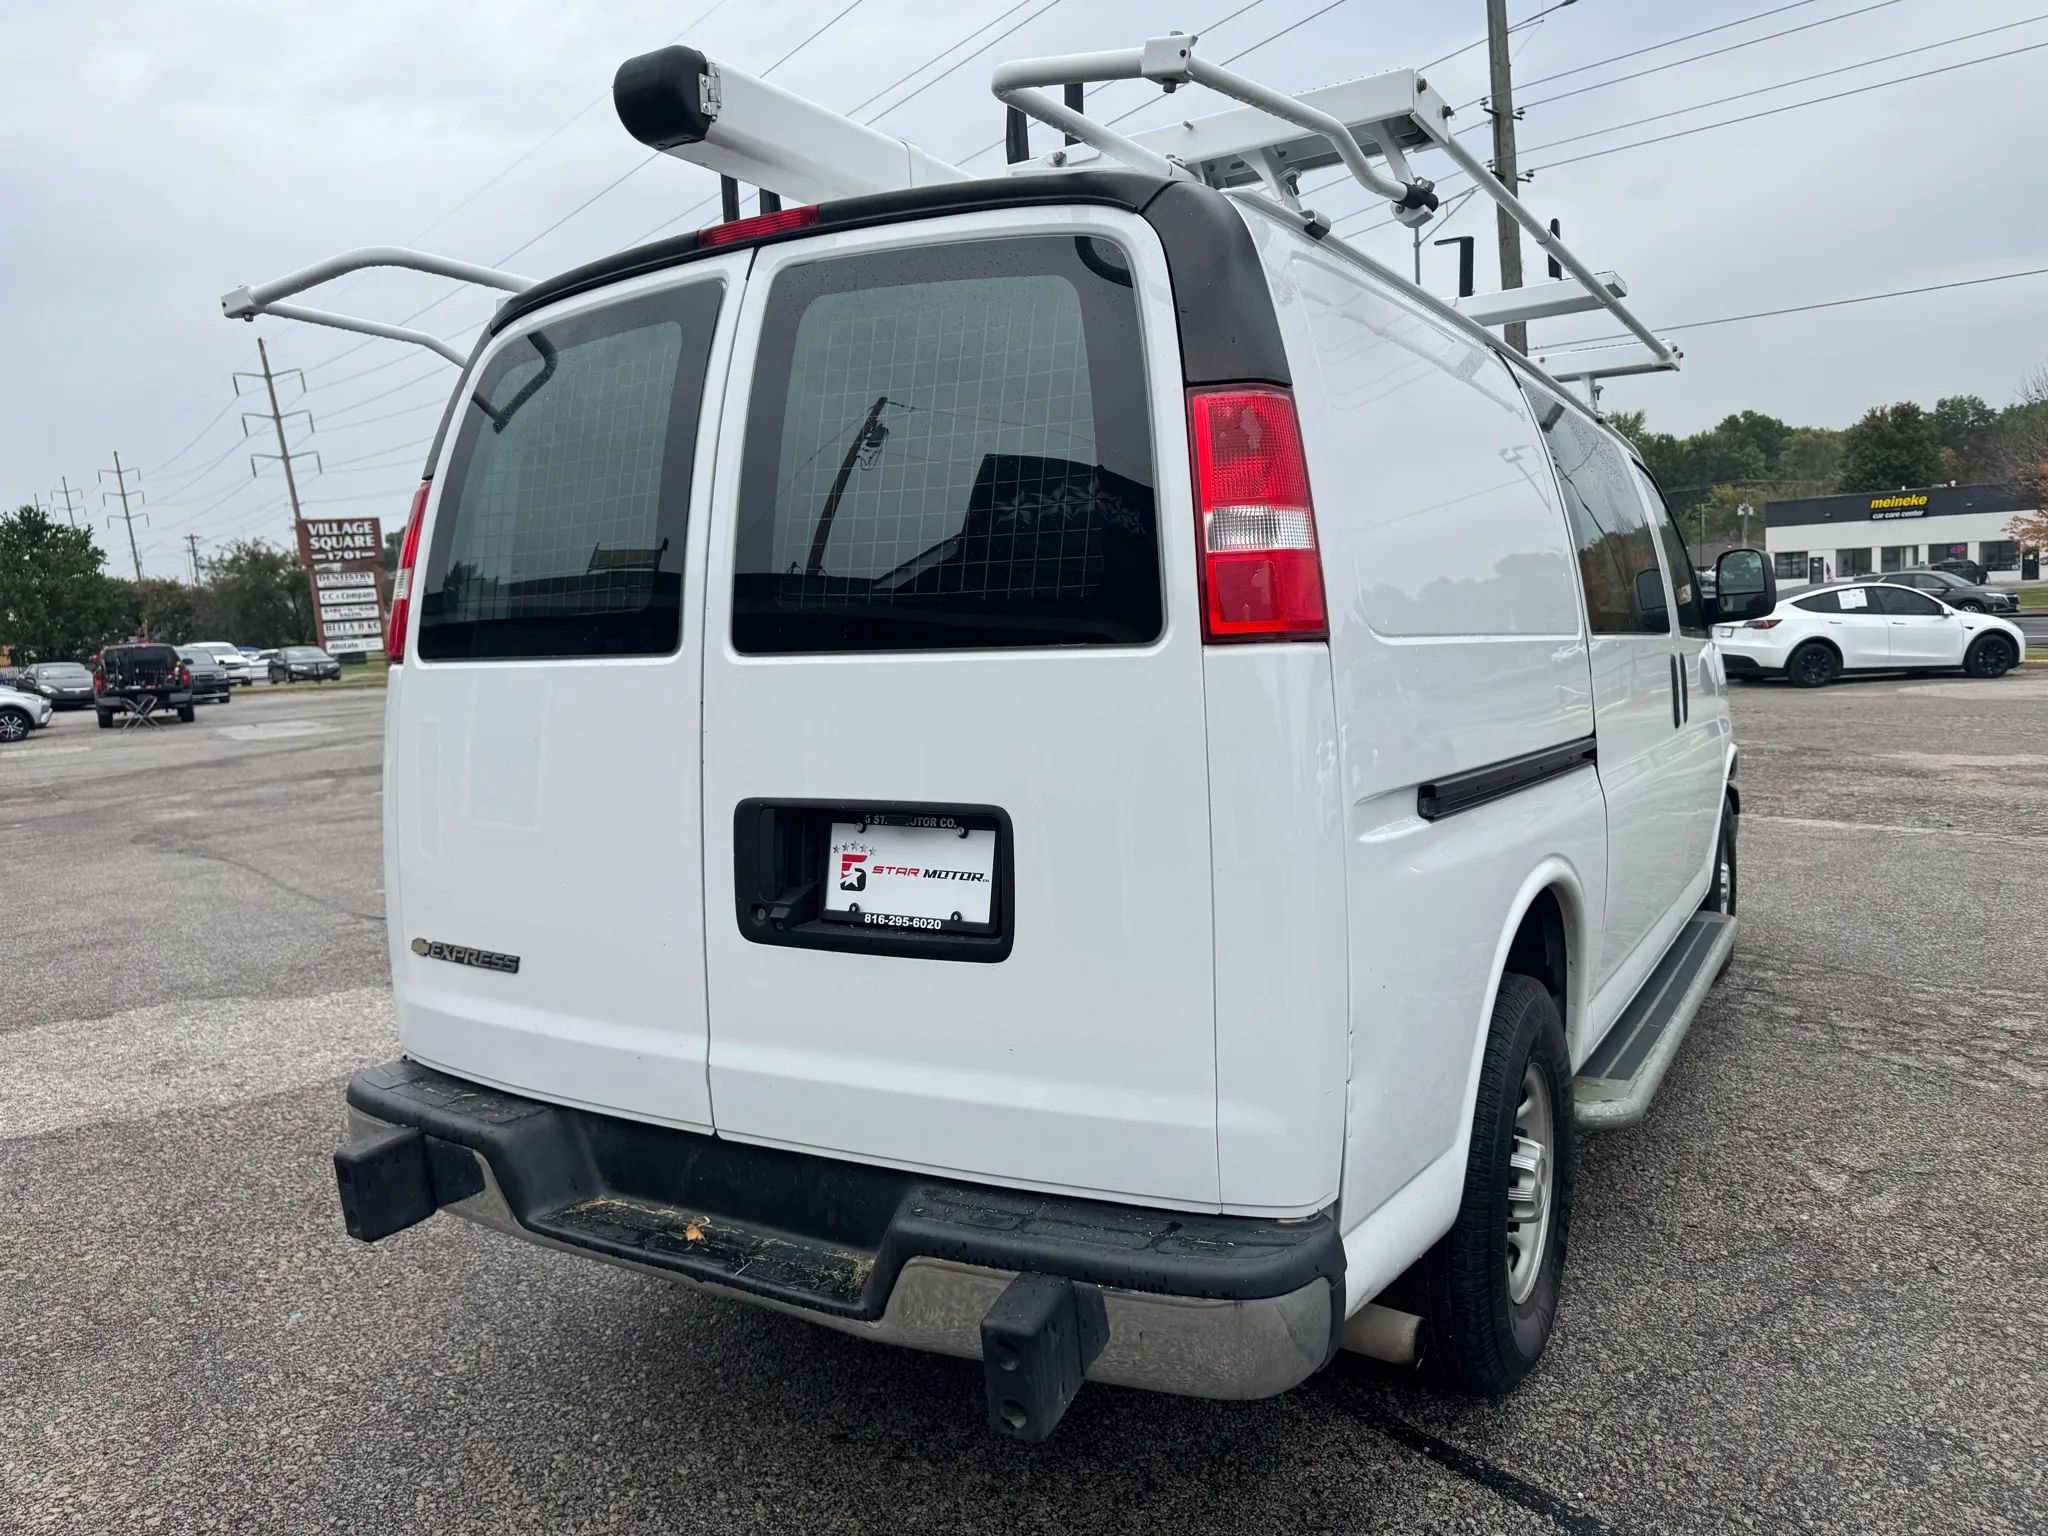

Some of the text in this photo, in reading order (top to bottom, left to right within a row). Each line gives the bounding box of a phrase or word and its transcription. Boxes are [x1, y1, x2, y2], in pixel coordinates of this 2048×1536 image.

[1870, 494, 1929, 509] meineke
[1884, 511, 1900, 519] care
[1900, 510, 1924, 518] center
[307, 521, 374, 536] VILLAGE
[309, 534, 375, 551] SQUARE
[326, 549, 361, 561] 1701
[318, 573, 371, 582] DENTISTRY
[939, 817, 957, 829] CO.
[871, 865, 921, 878] STAR
[923, 868, 984, 883] MOTOR
[864, 913, 942, 930] 816-295-6020
[429, 941, 520, 974] EXPRESS
